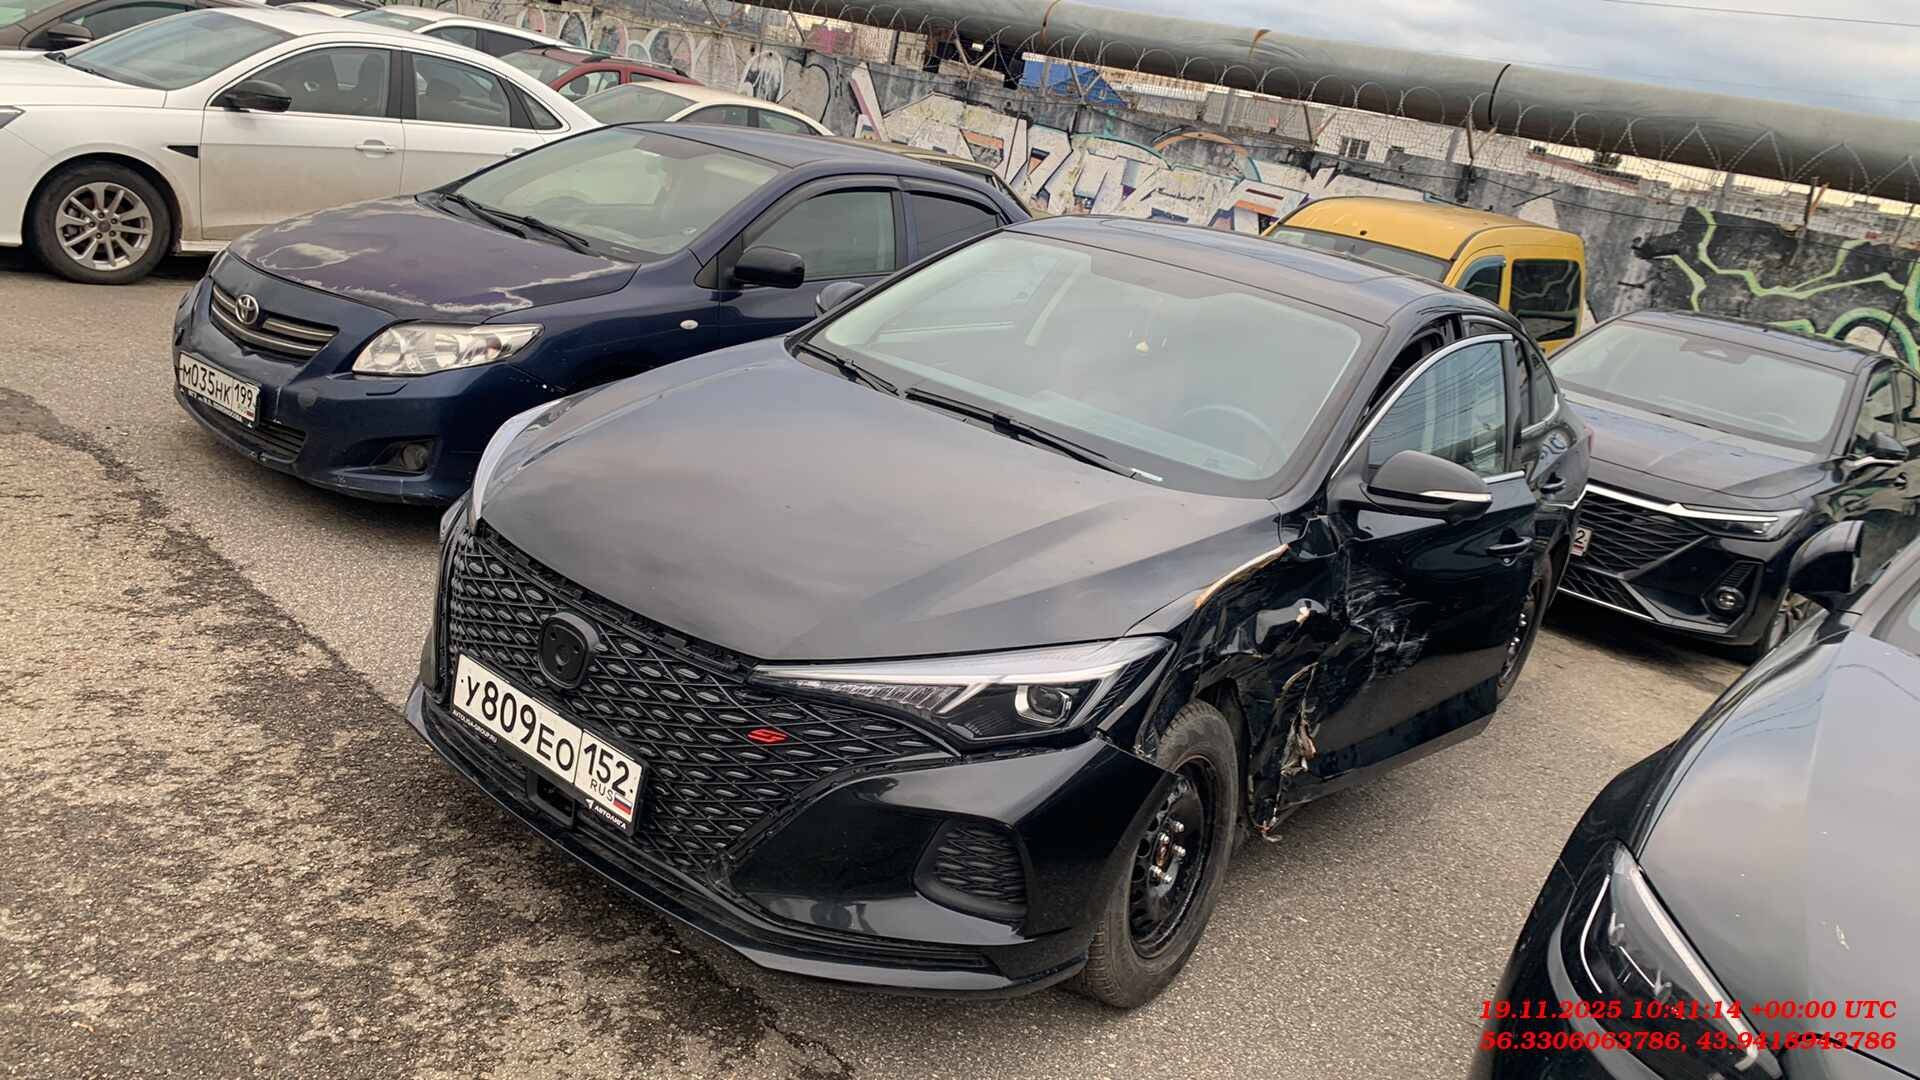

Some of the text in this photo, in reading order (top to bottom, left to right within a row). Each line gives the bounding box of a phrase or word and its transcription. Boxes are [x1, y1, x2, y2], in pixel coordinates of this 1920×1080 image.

[182, 364, 253, 407] М035НК 199
[466, 674, 575, 772] У809ЕО
[583, 743, 630, 796] 152
[590, 778, 613, 802] RUS
